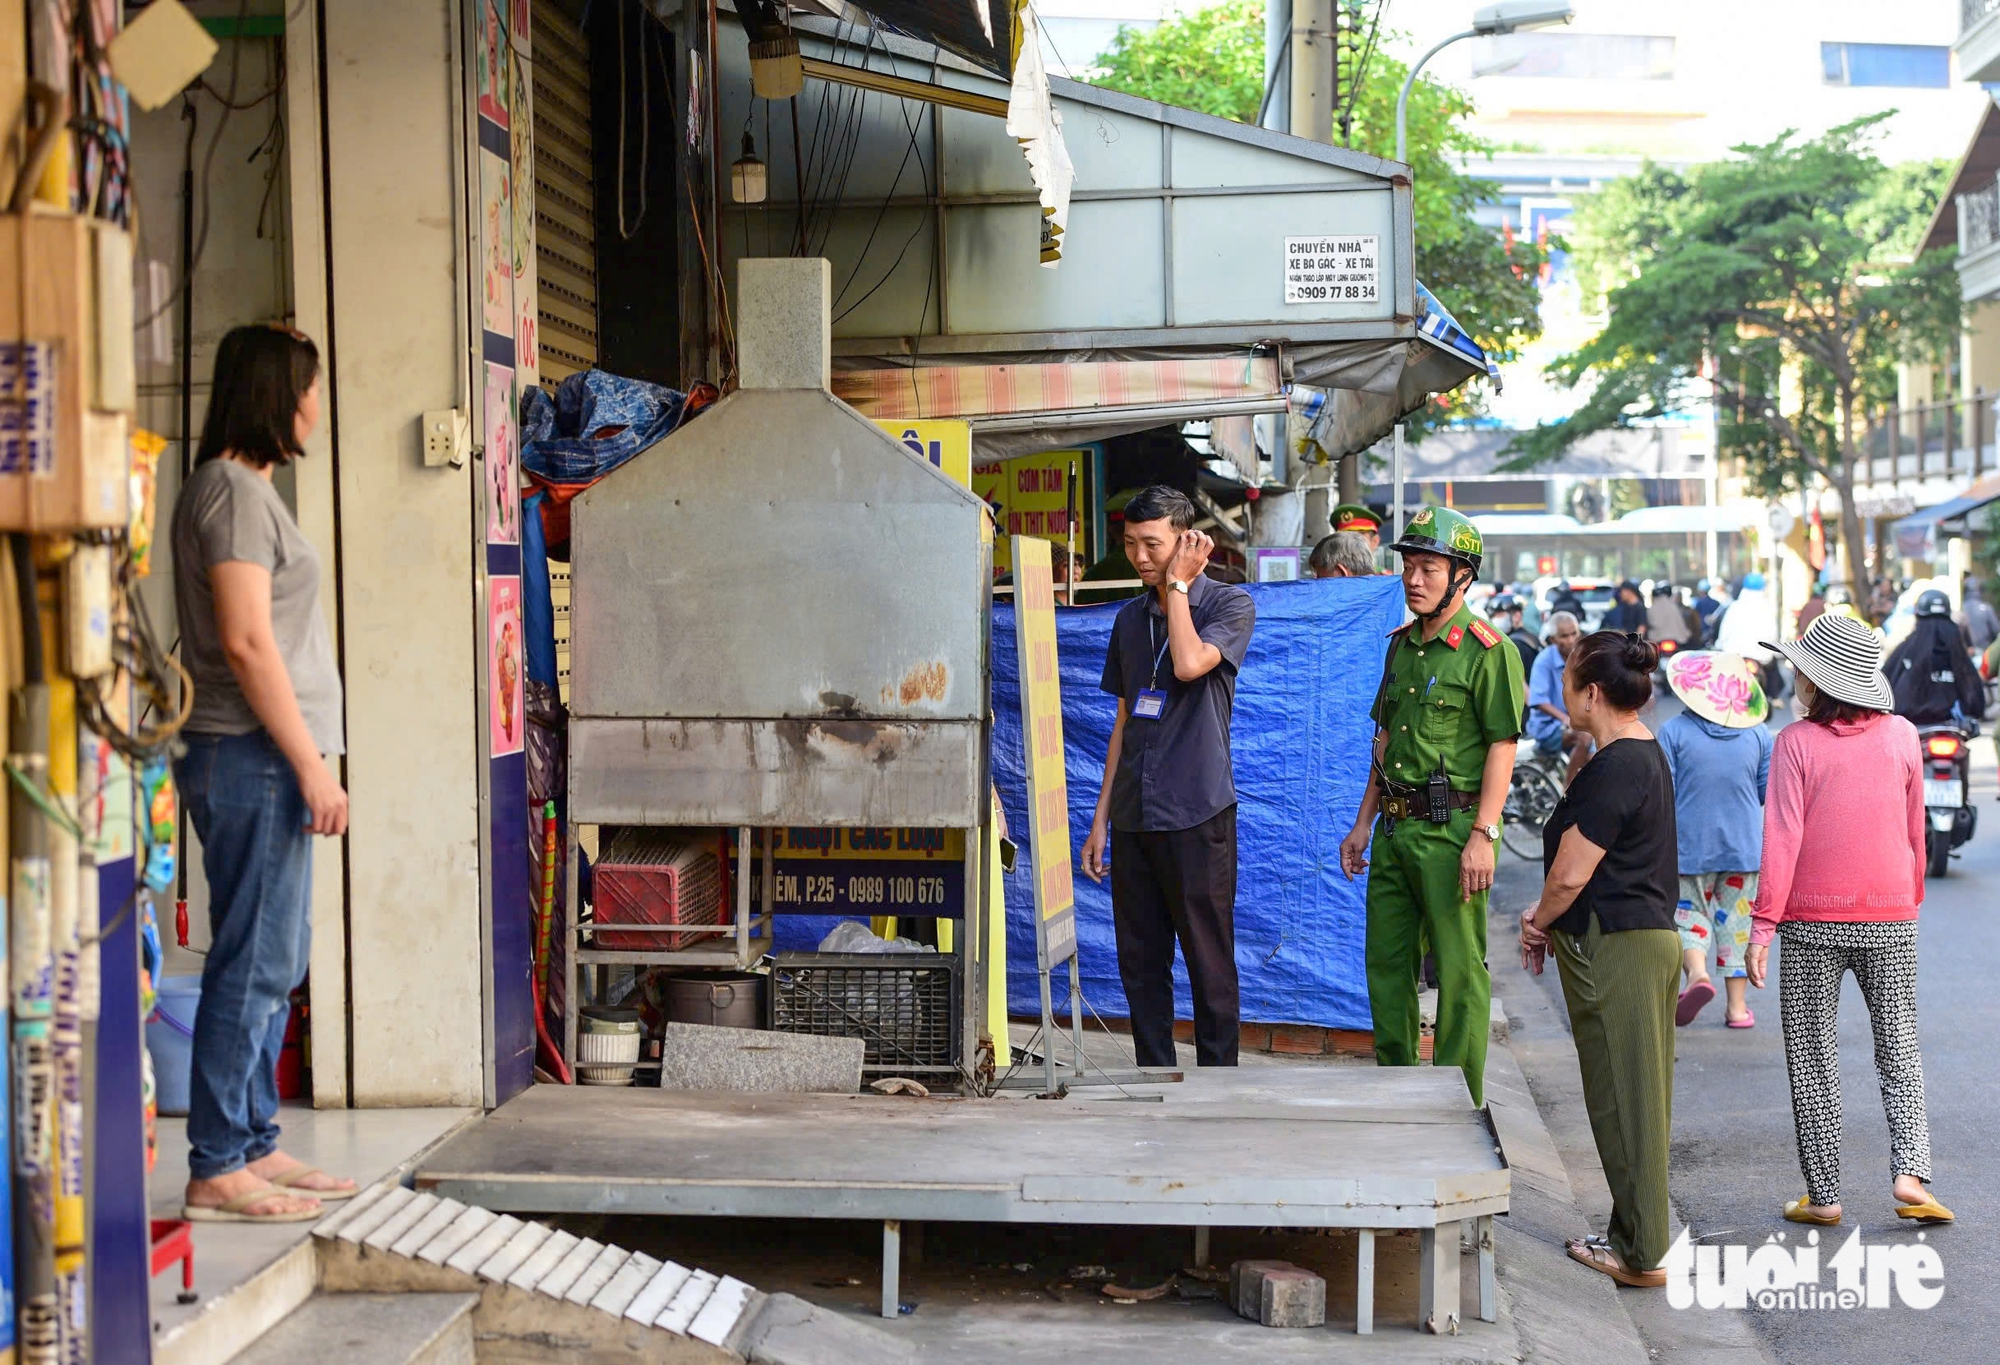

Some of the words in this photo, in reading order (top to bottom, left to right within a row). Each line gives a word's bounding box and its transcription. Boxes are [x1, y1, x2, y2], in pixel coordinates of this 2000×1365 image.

[1290, 238, 1334, 253] CHUYỂN
[1338, 240, 1361, 253] NHÀ
[1289, 258, 1300, 269] XE
[1303, 258, 1314, 269] BA
[1317, 256, 1335, 269] GÁC
[1345, 258, 1357, 269] XE
[1297, 286, 1326, 298] 0909
[1330, 286, 1342, 298] 77
[1345, 286, 1359, 298] 88
[1362, 286, 1375, 298] 34
[1018, 467, 1039, 493] CƠM
[1042, 460, 1062, 492] TẤM
[1008, 507, 1022, 535] ÚN
[1047, 508, 1080, 534] NƯỚG
[1456, 535, 1480, 552] CSTT
[806, 876, 835, 902] P.25
[849, 877, 884, 903] 0989
[888, 877, 914, 903] 100
[918, 877, 944, 904] 676
